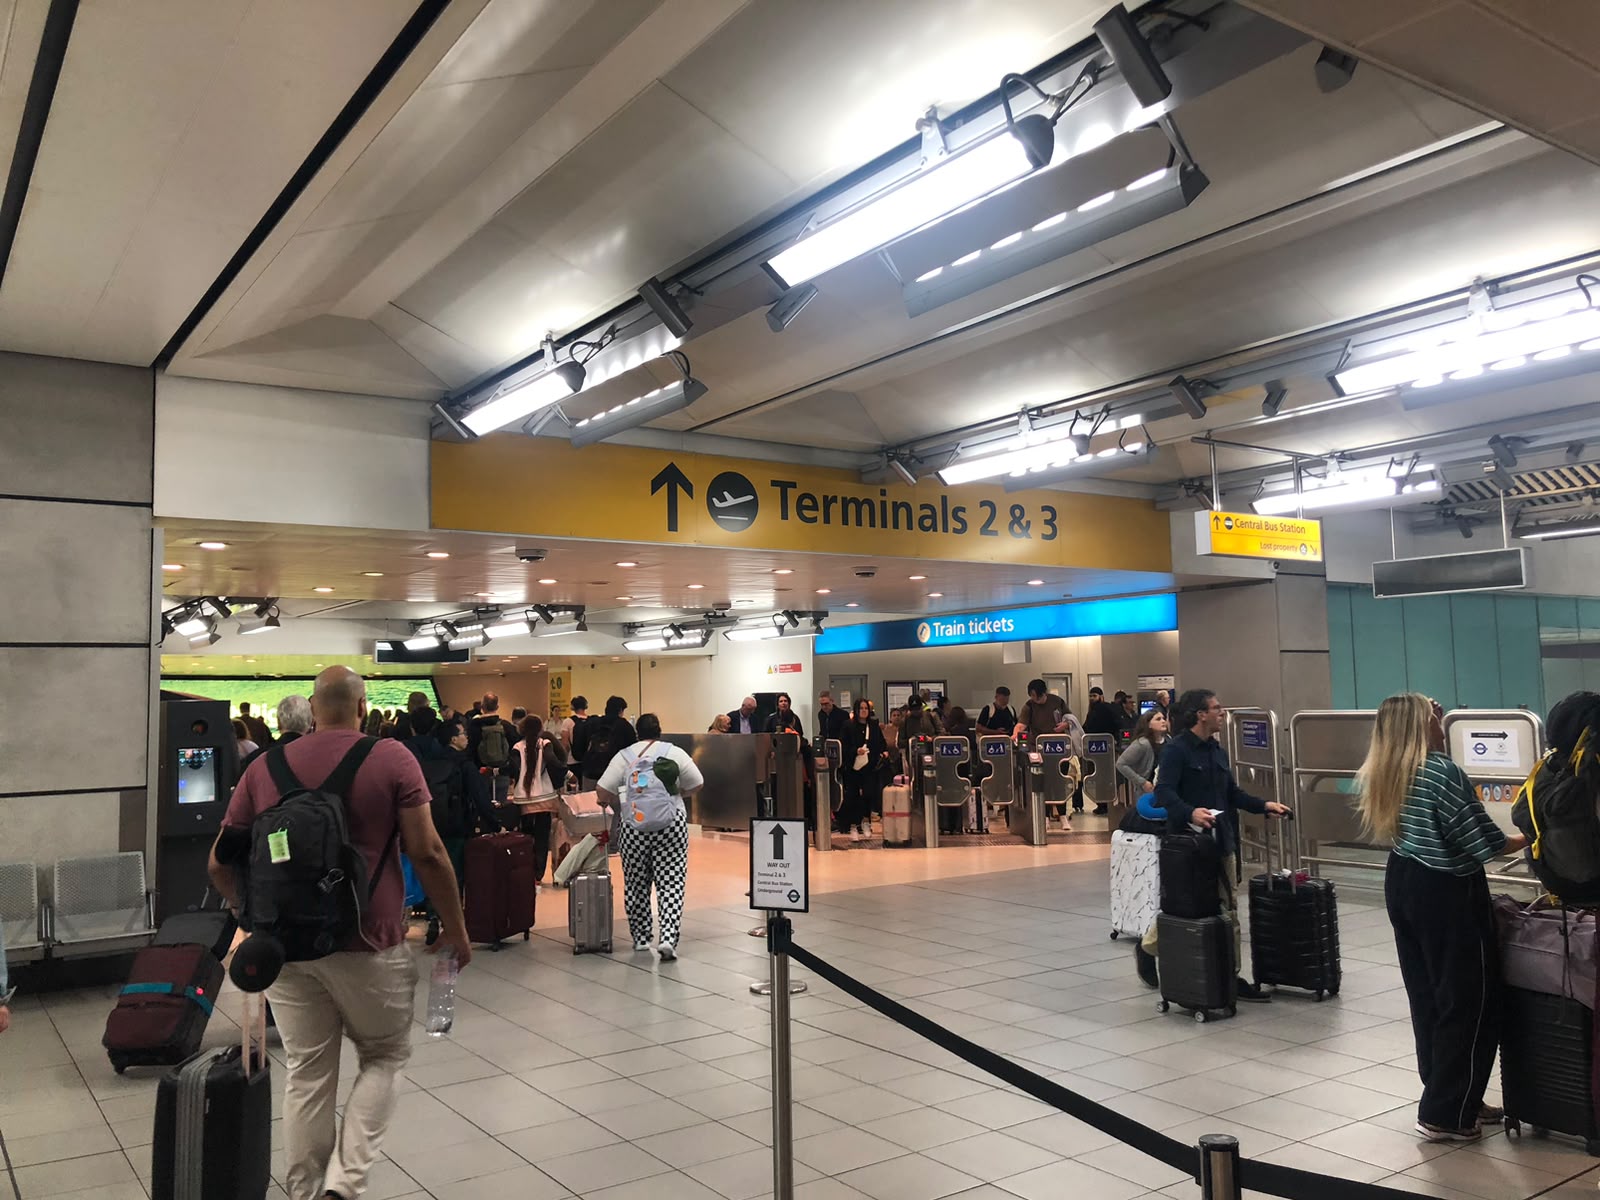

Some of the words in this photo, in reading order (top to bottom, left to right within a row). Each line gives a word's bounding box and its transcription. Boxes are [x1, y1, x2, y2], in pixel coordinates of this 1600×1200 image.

[770, 480, 968, 535] Terminals
[979, 499, 999, 537] 2
[1007, 503, 1033, 540] &
[1040, 505, 1058, 541] 3
[1234, 518, 1263, 531] Central
[1264, 521, 1278, 532] Bus
[1280, 522, 1306, 535] Station
[1260, 541, 1273, 550] Lost
[1273, 543, 1298, 553] property
[932, 619, 965, 637] Train
[968, 616, 1015, 635] tickets
